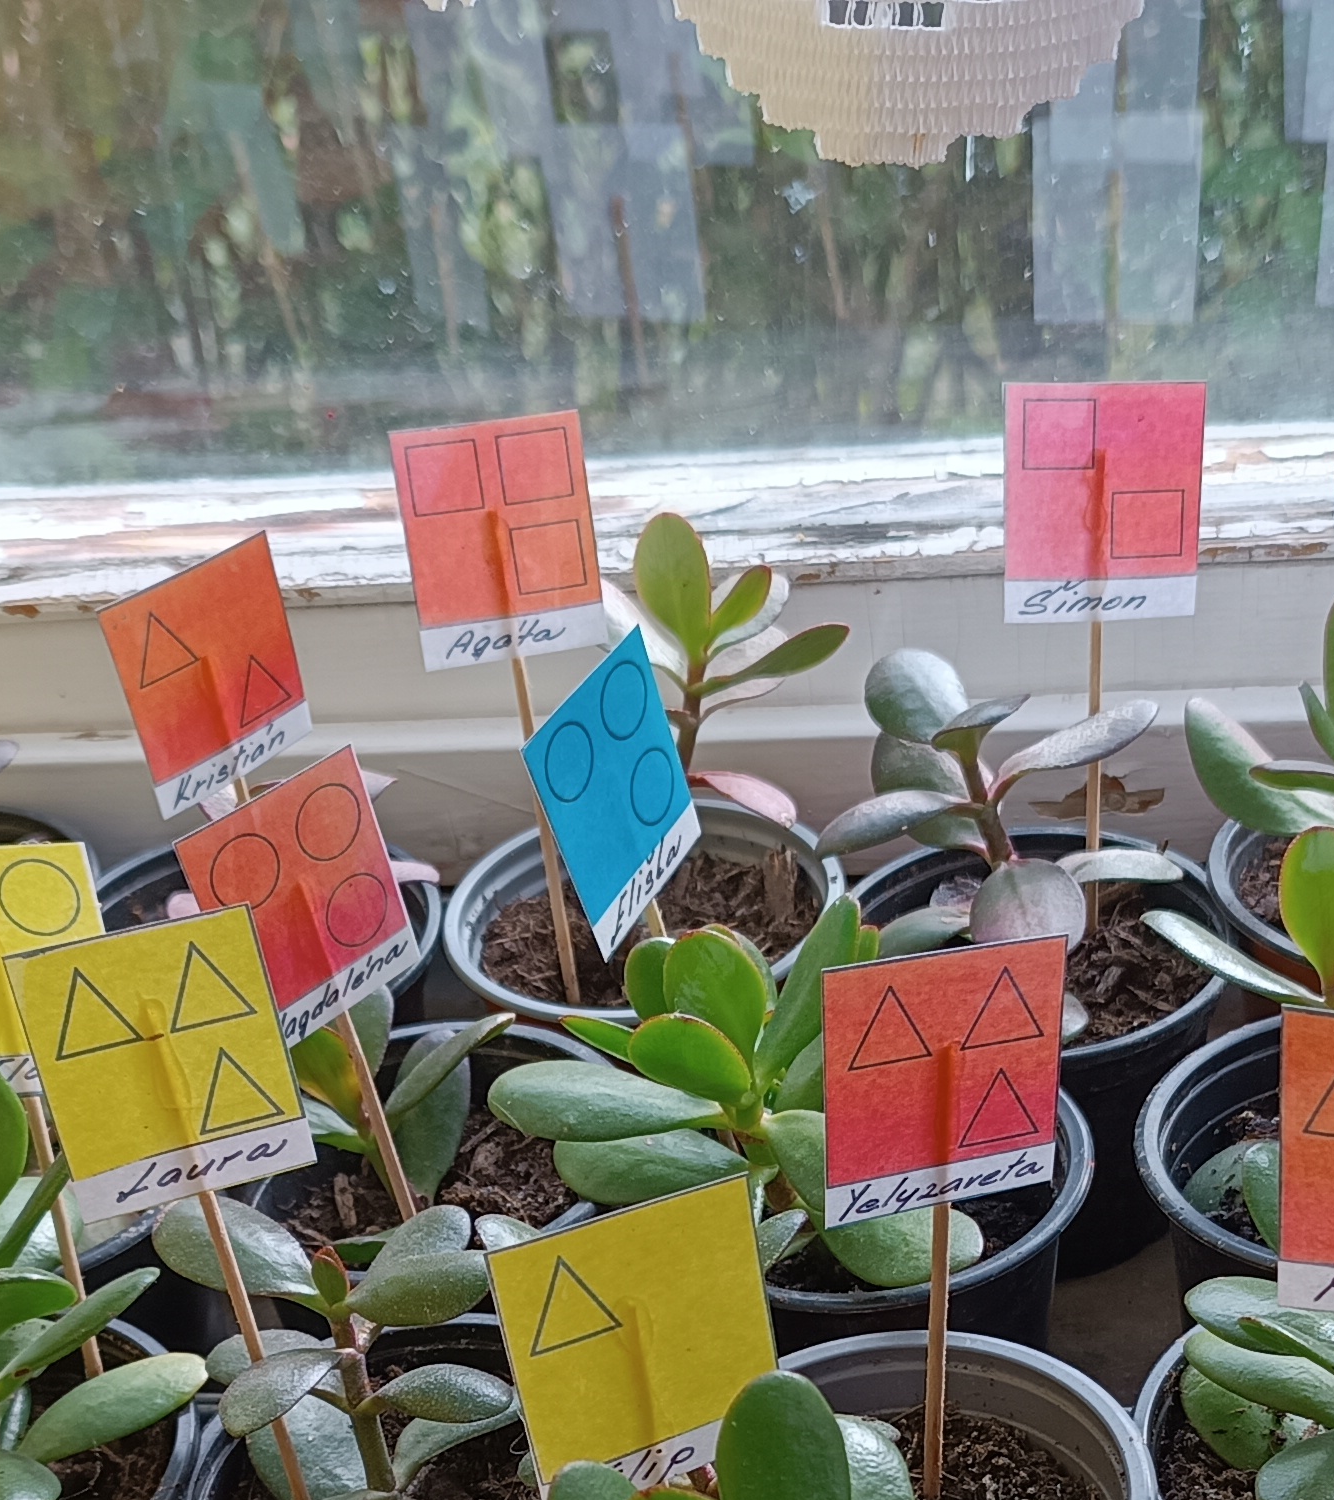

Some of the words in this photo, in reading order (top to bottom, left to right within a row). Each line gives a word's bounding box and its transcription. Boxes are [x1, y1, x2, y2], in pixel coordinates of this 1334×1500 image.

[1017, 579, 1148, 616] Šimon
[446, 618, 567, 661] Agáta
[173, 722, 286, 810] Kristián
[611, 834, 683, 948] Eliška
[279, 939, 409, 1041] agdaléna
[115, 1138, 288, 1204] Laura
